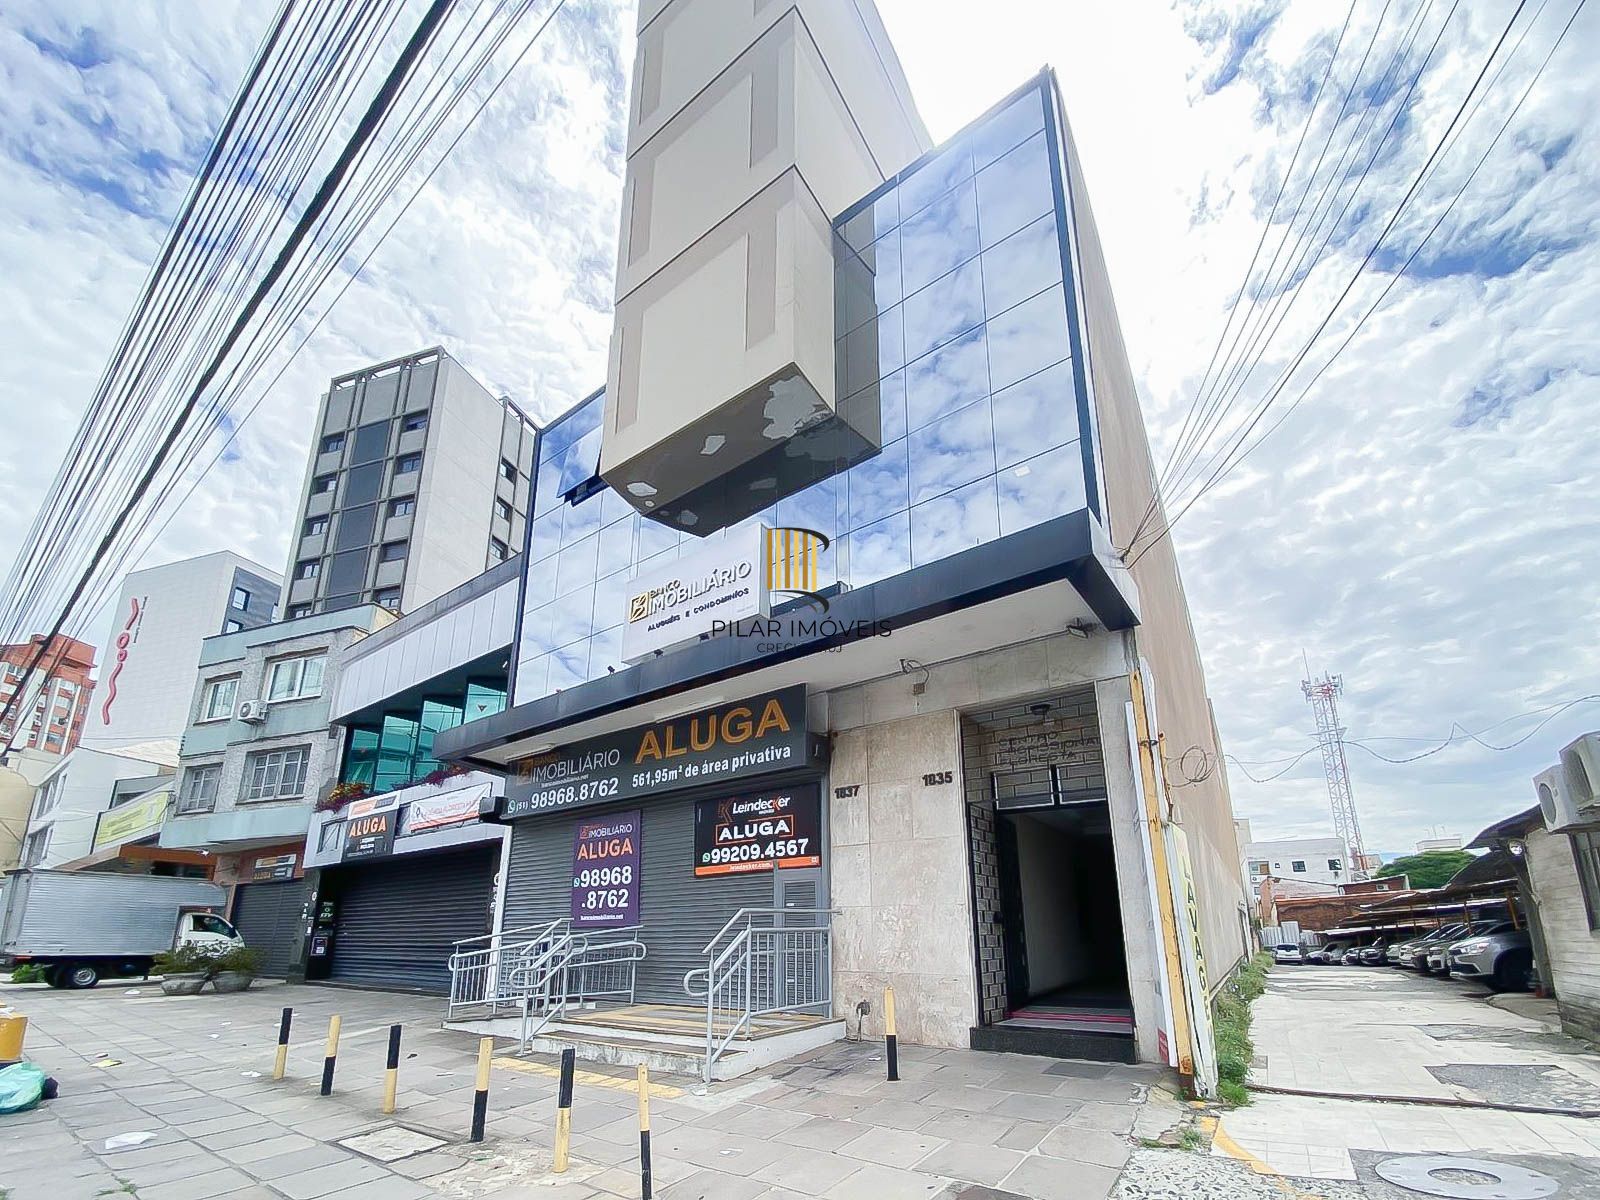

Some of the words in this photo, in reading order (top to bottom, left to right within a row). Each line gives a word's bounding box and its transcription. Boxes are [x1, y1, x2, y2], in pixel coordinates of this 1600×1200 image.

[648, 560, 752, 616] IMOBILIÁRIO
[635, 699, 790, 764] ALUGA
[533, 749, 620, 782] IMOBILIÁRIO
[632, 764, 682, 788] 561,95m²
[685, 763, 699, 778] de
[701, 759, 729, 775] área
[732, 746, 791, 772] privativa
[531, 777, 619, 809] 98968.8762
[349, 816, 387, 838] ALUGA
[718, 820, 790, 841] ALUGA
[577, 838, 632, 860] ALUGA
[711, 838, 809, 863] 99209.4567
[580, 865, 632, 888] 98968
[581, 888, 629, 909] .8762
